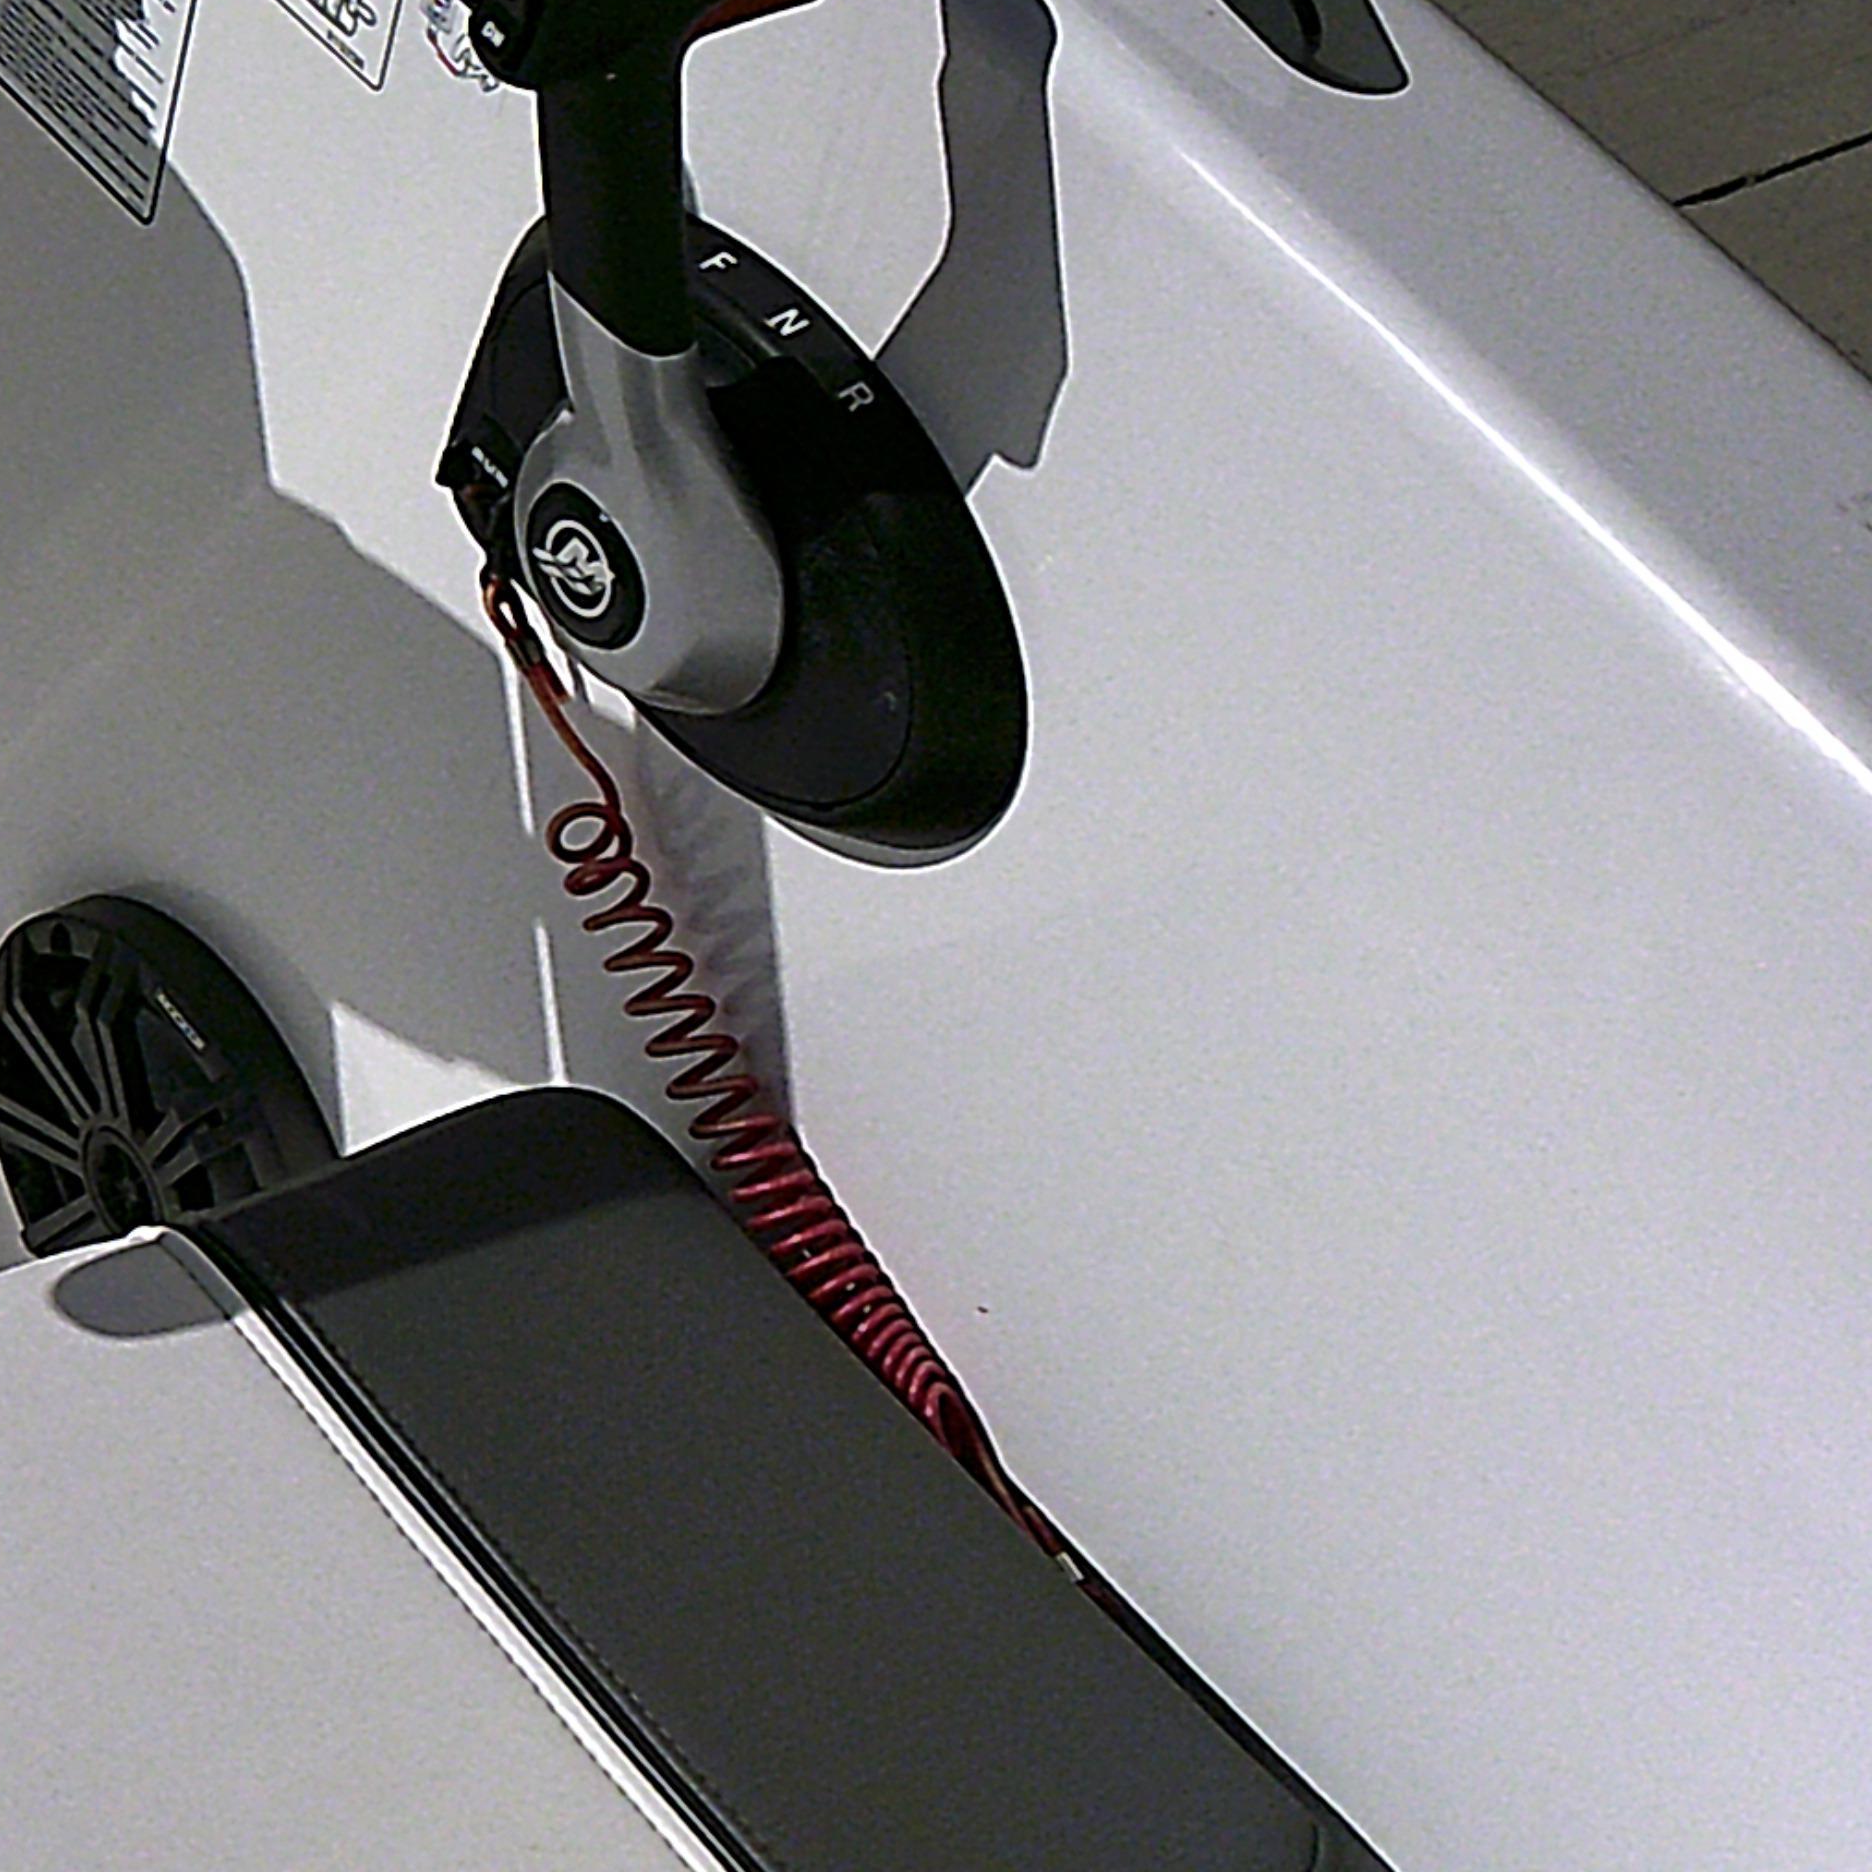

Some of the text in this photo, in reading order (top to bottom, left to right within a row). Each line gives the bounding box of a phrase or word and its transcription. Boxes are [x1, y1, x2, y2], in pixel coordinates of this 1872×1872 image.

[698, 249, 740, 275] F
[763, 307, 812, 339] N
[837, 381, 876, 413] R
